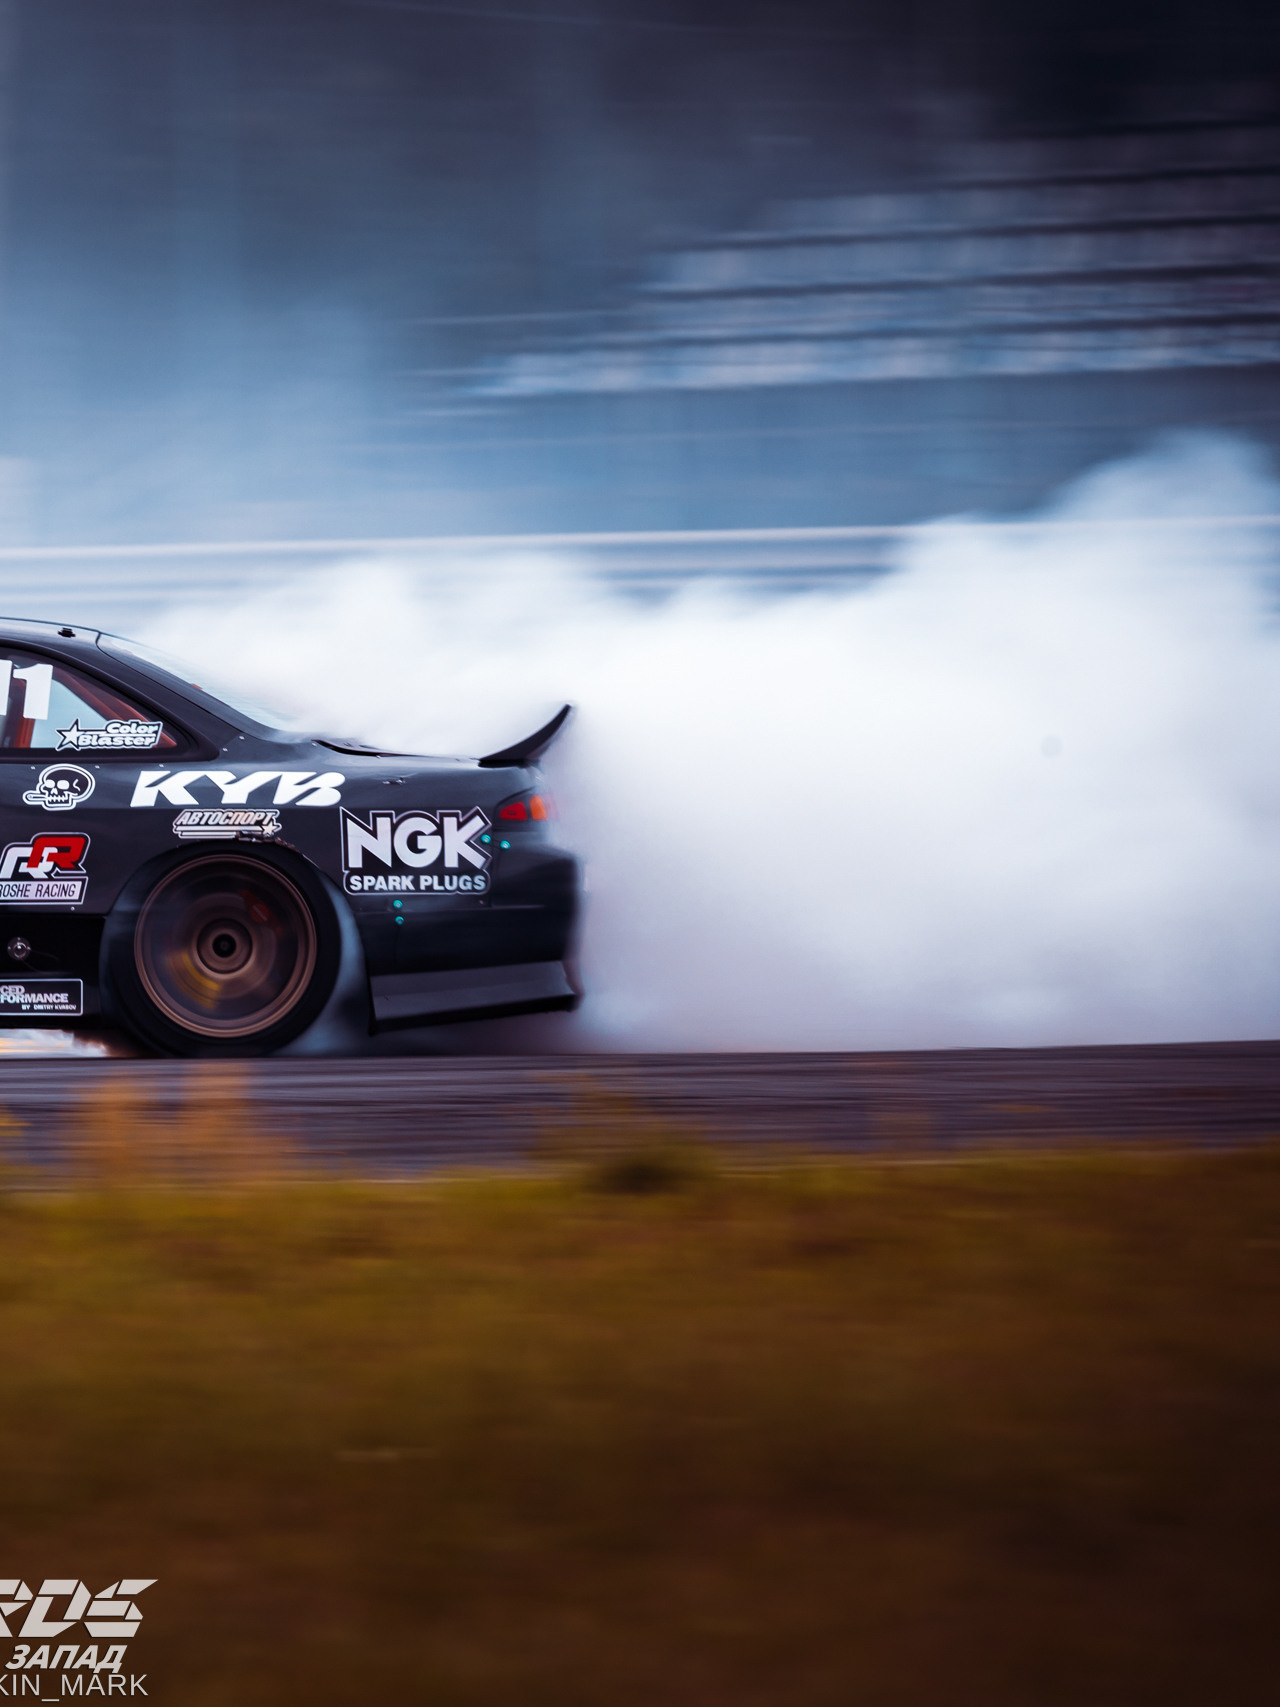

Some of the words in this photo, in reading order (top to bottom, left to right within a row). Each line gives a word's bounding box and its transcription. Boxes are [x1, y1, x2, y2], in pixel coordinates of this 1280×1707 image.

[106, 723, 158, 733] Color
[78, 734, 156, 747] Blaster
[130, 770, 345, 807] KYB
[176, 811, 275, 826] АВТОСПОРТ
[346, 815, 487, 869] NGK
[35, 883, 76, 898] RACING
[349, 875, 416, 891] SPARK
[419, 875, 486, 891] PLUGS
